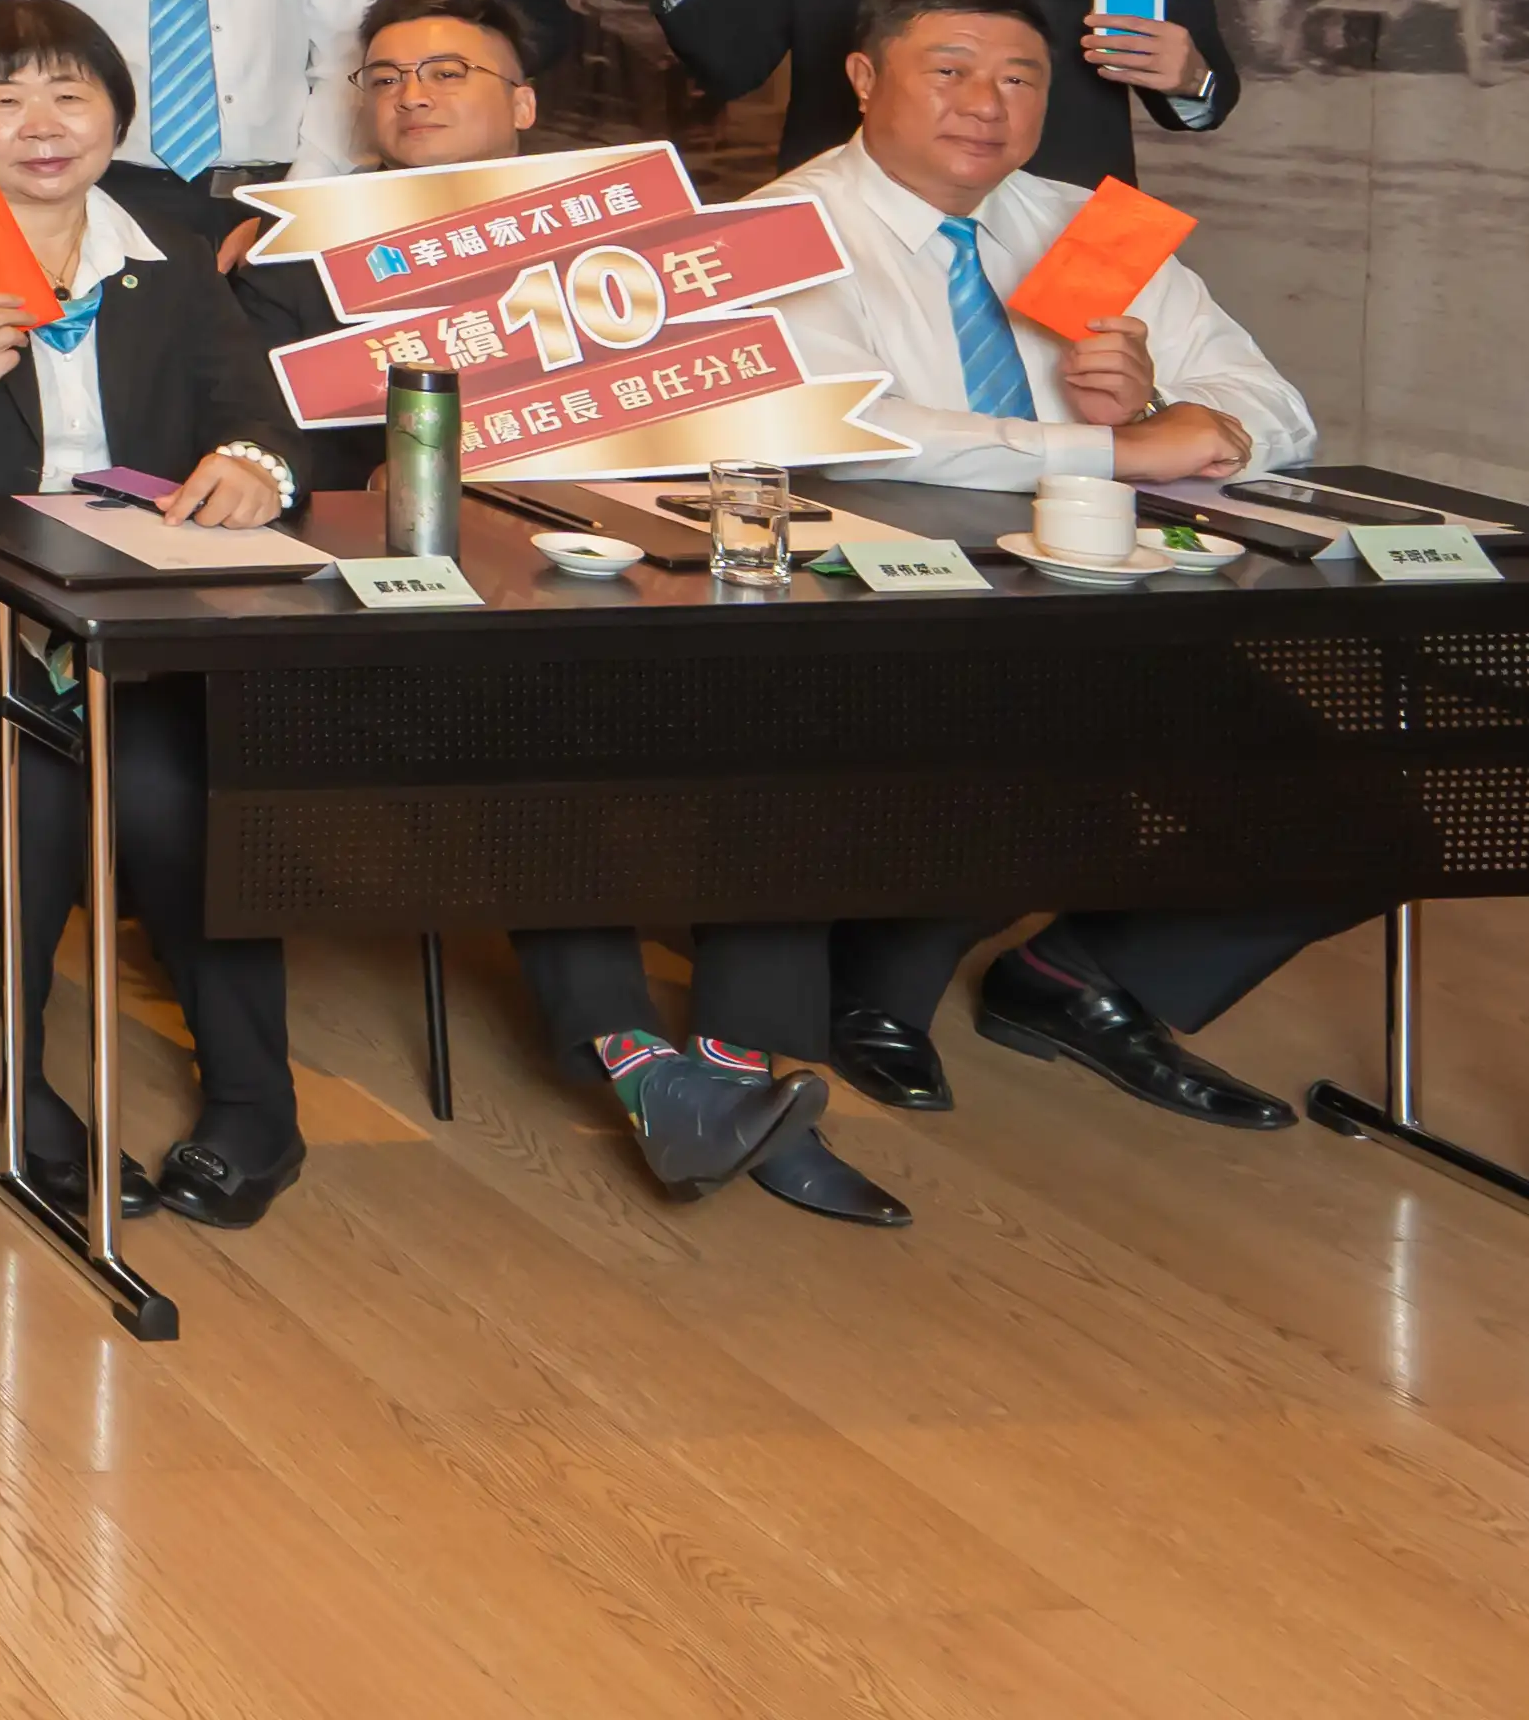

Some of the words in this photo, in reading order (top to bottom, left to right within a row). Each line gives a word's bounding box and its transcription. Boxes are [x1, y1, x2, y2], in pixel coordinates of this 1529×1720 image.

[409, 182, 642, 268] 幸福家不動產
[365, 245, 733, 373] 連續10年
[610, 343, 777, 411] 留任分紅
